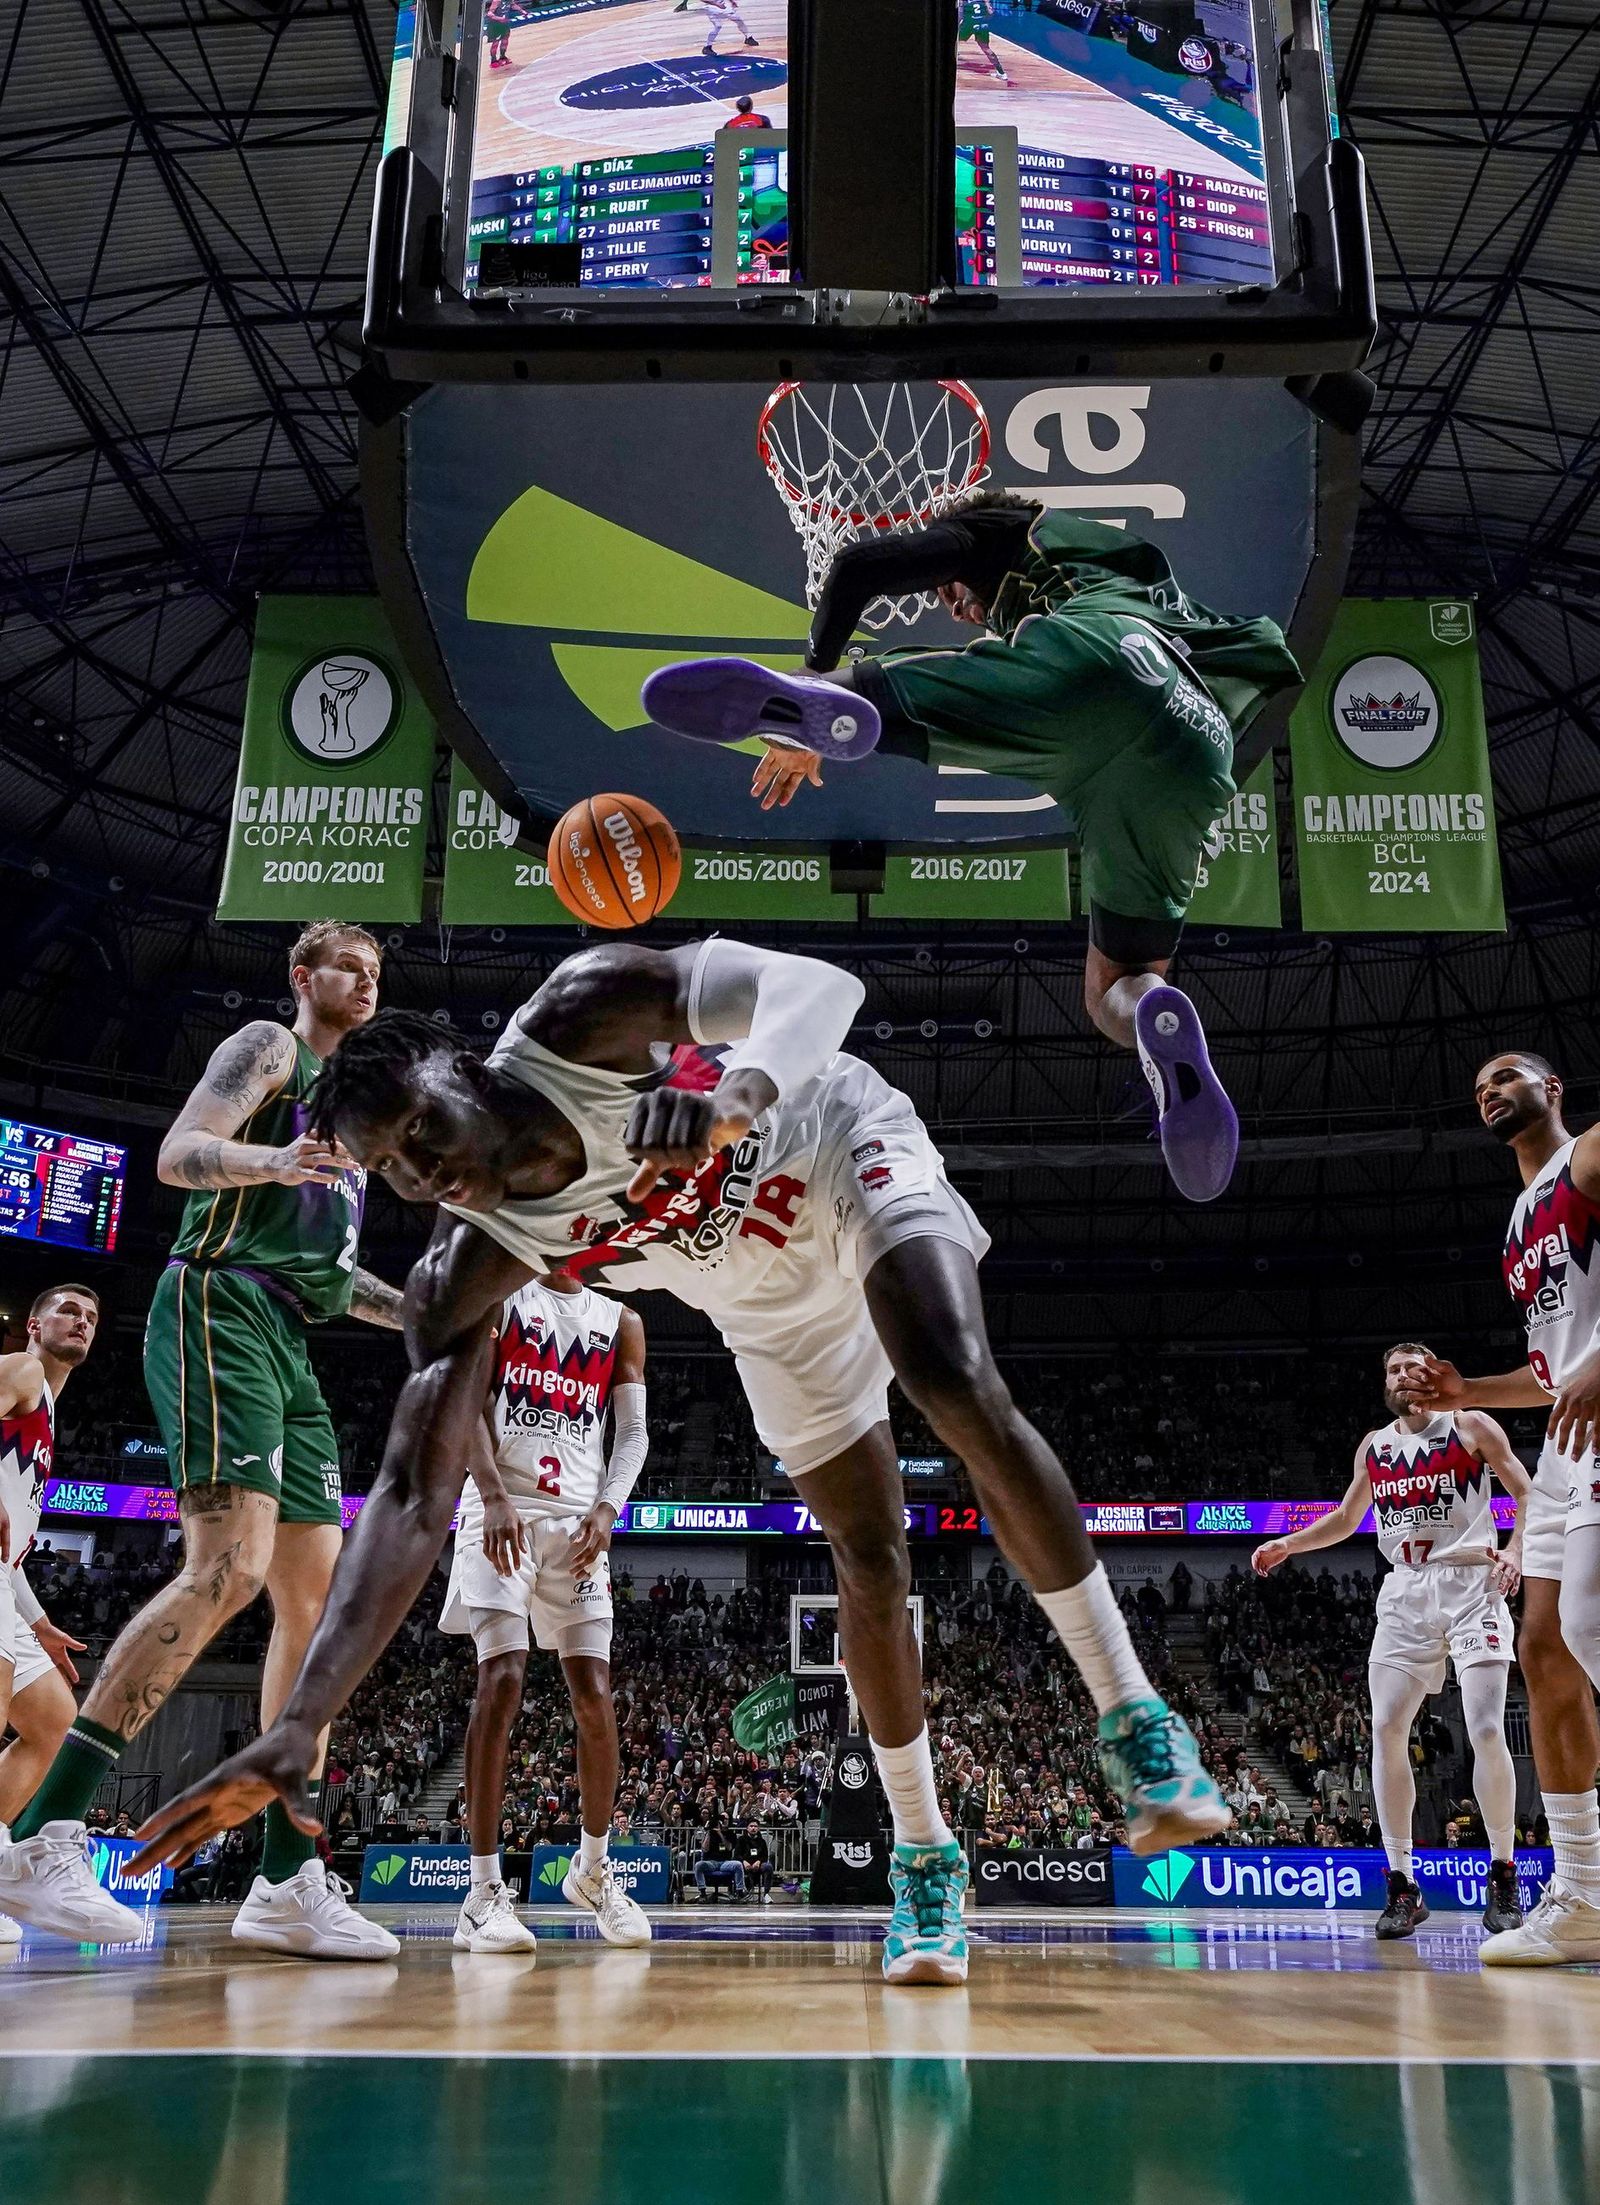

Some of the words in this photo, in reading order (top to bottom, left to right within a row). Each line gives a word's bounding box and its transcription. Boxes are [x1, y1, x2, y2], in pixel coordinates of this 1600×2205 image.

[603, 159, 633, 173] DÍAZ
[706, 153, 714, 162] 2
[1018, 154, 1065, 169] OWARD
[1109, 165, 1117, 175] 4
[1122, 167, 1130, 176] F
[1136, 168, 1154, 179] 16
[516, 177, 524, 187] 0
[528, 173, 536, 183] F
[546, 170, 555, 180] 6
[608, 173, 701, 193] SULEJMANOVIC
[705, 173, 713, 183] 3
[1177, 174, 1194, 187] 17
[1206, 180, 1267, 202] RADZEVIC
[516, 197, 521, 207] 1
[526, 194, 534, 204] F
[544, 191, 554, 202] 2
[1110, 187, 1116, 196] 1
[1123, 187, 1130, 196] F
[1140, 189, 1150, 200] 7
[579, 204, 595, 218] 21
[609, 199, 649, 214] RUBIT
[705, 195, 711, 204] 1
[986, 194, 995, 205] 2
[1111, 207, 1119, 217] 3
[1124, 208, 1131, 217] F
[1138, 210, 1156, 222] 16
[1206, 200, 1237, 215] DIOP
[512, 217, 520, 227] 4
[524, 215, 533, 225] F
[543, 211, 552, 222] 4
[578, 226, 595, 239] 27
[608, 219, 661, 235] DUARTE
[704, 216, 710, 226] 1
[741, 213, 749, 223] 7
[986, 216, 995, 226] 4
[1112, 228, 1120, 238] 0
[1125, 229, 1132, 238] F
[1143, 231, 1152, 242] 4
[1179, 216, 1197, 229] 25
[1208, 220, 1254, 240] FRISCH
[607, 241, 646, 256] TILLIE
[702, 237, 710, 247] 3
[739, 235, 748, 244] 2
[987, 237, 995, 247] 5
[1021, 239, 1072, 255] MORUYI
[1112, 249, 1121, 259] 3
[1126, 250, 1133, 260] F
[1144, 253, 1153, 264] 2
[605, 262, 649, 278] PERRY
[702, 259, 708, 268] 1
[1113, 271, 1122, 281] 2
[1127, 271, 1135, 281] F
[1140, 274, 1158, 285] 17
[1346, 710, 1387, 720] FINAL
[1389, 710, 1426, 720] FOUR
[238, 786, 424, 825] CAMPEONES
[1303, 794, 1486, 832] CAMPEONES
[244, 826, 314, 847] COPA
[321, 826, 411, 847] KORAC
[452, 829, 507, 849] COP
[1222, 832, 1271, 854] REY
[1306, 833, 1374, 843] BASKETBALL
[1379, 833, 1441, 842] CHAMPIONS
[1446, 832, 1487, 842] LEAGUE
[604, 811, 647, 903] Wilson
[1374, 843, 1426, 864] BCL
[263, 861, 385, 884] 2000/2001
[694, 858, 820, 882] 2005/2006
[911, 858, 1027, 882] 2016/2017
[1368, 871, 1431, 894] 2024
[5, 1125, 24, 1143] VS
[34, 1134, 55, 1150] 74
[855, 1147, 878, 1160] acb
[16, 1208, 26, 1220] 2
[503, 1361, 600, 1406] kingroyal
[505, 1406, 591, 1444] Kosner
[908, 1460, 943, 1468] Fundación
[908, 1466, 934, 1475] Unicaja
[536, 1456, 561, 1497] 2
[1372, 1469, 1456, 1500] kingroyal
[673, 1509, 748, 1529] UNICAJA
[941, 1508, 977, 1529] 2.2
[1097, 1507, 1145, 1519] KOSNER
[1199, 1506, 1246, 1522] ALICE
[1380, 1504, 1453, 1530] Kosner
[1085, 1519, 1146, 1532] BASKONIA
[1401, 1540, 1434, 1565] 17
[843, 1773, 864, 1785] Risi
[410, 1856, 471, 1871] Fundac
[832, 1842, 873, 1868] Risi
[981, 1854, 1106, 1882] endesa
[1412, 1856, 1487, 1877] Partido
[409, 1871, 470, 1890] Unicaja
[1202, 1856, 1362, 1908] Unicaja
